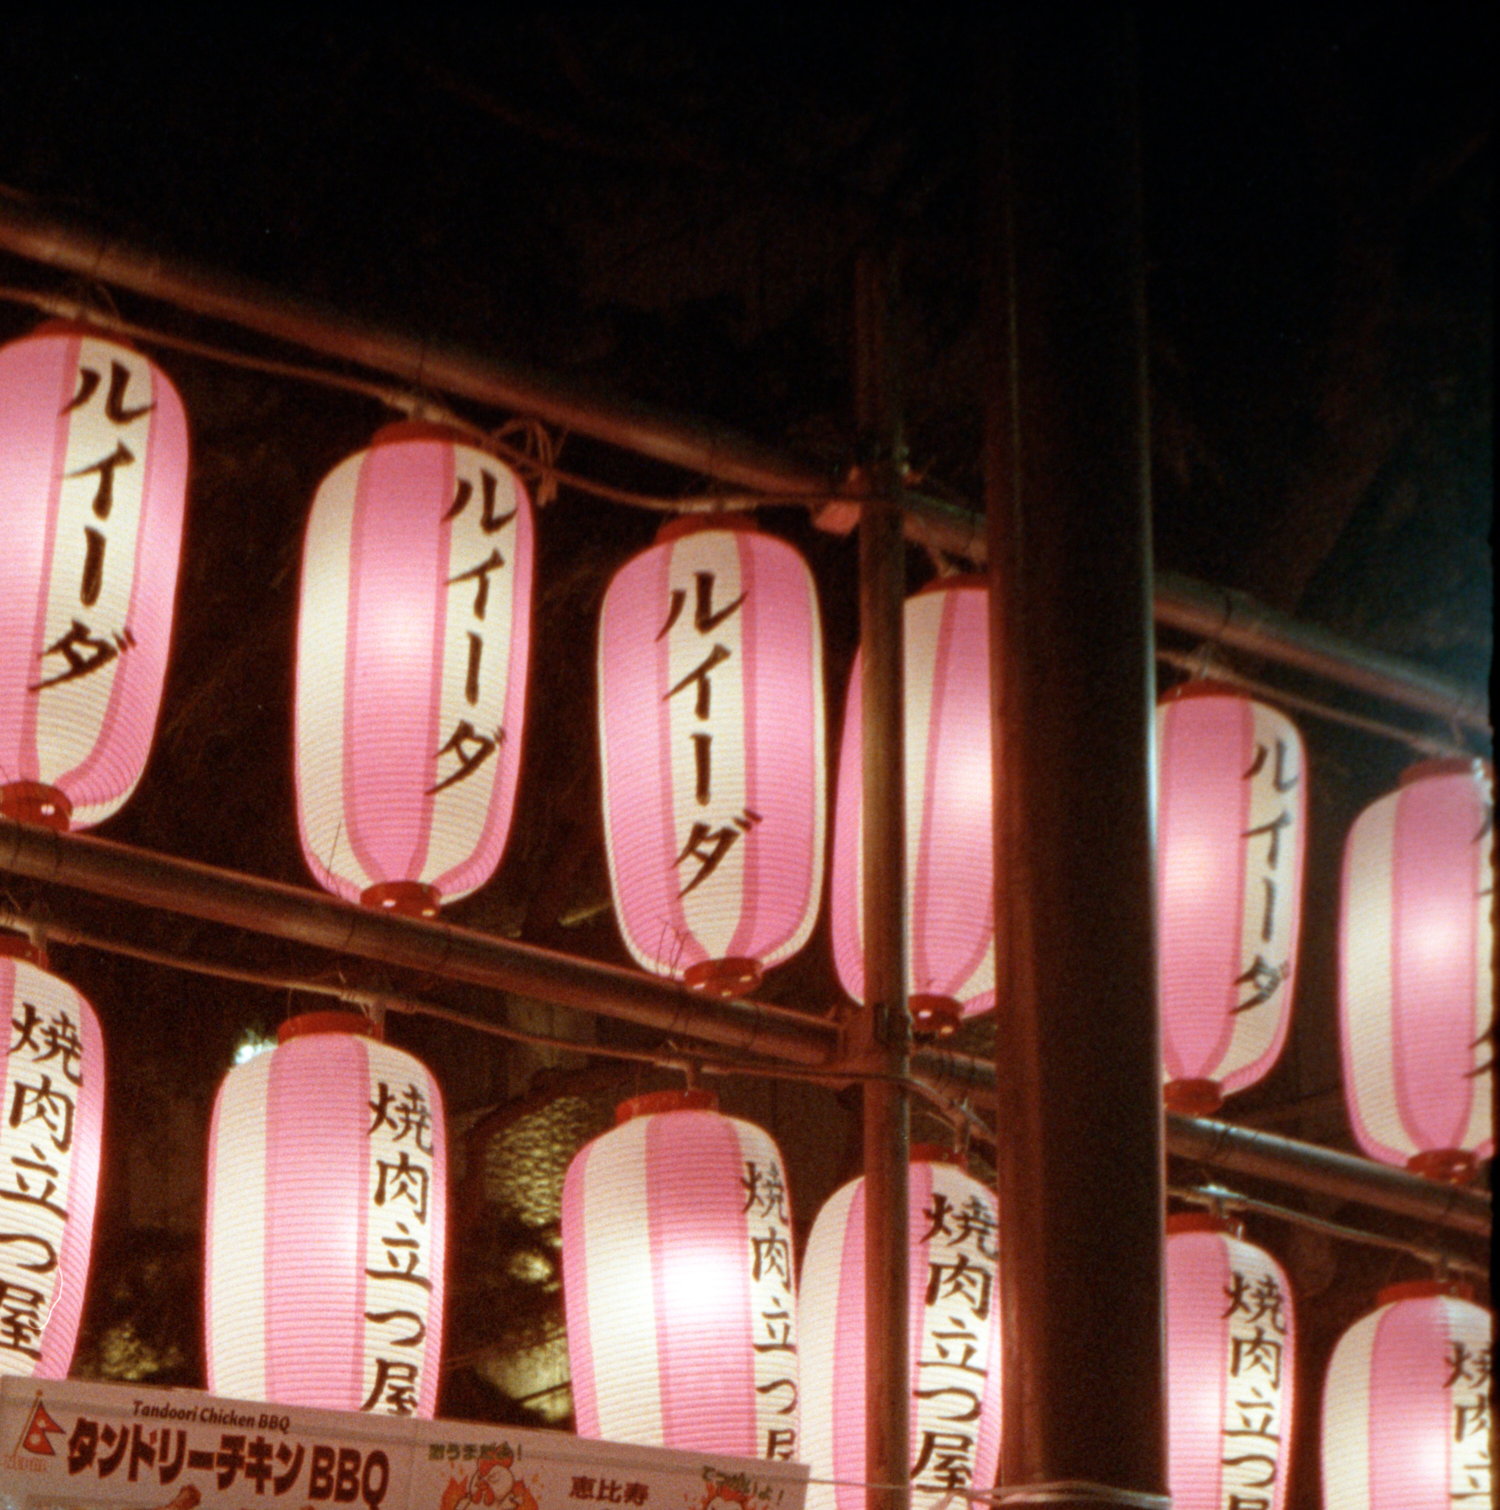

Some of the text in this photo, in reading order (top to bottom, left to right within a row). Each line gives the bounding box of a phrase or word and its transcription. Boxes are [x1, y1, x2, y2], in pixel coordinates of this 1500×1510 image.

[26, 358, 157, 692] ルイーダ
[425, 467, 518, 796] ルイーダ
[654, 571, 763, 899] ルイーダ
[1230, 736, 1302, 1016] ルイーダ
[359, 1080, 437, 1419] 焼肉立つ屋
[909, 1192, 999, 1498] 焼肉立つ屋
[67, 1417, 305, 1496] タンドリーチキン
[131, 1400, 291, 1434] Tandoori Chicken BBQ
[569, 1475, 650, 1507] 恵比寿
